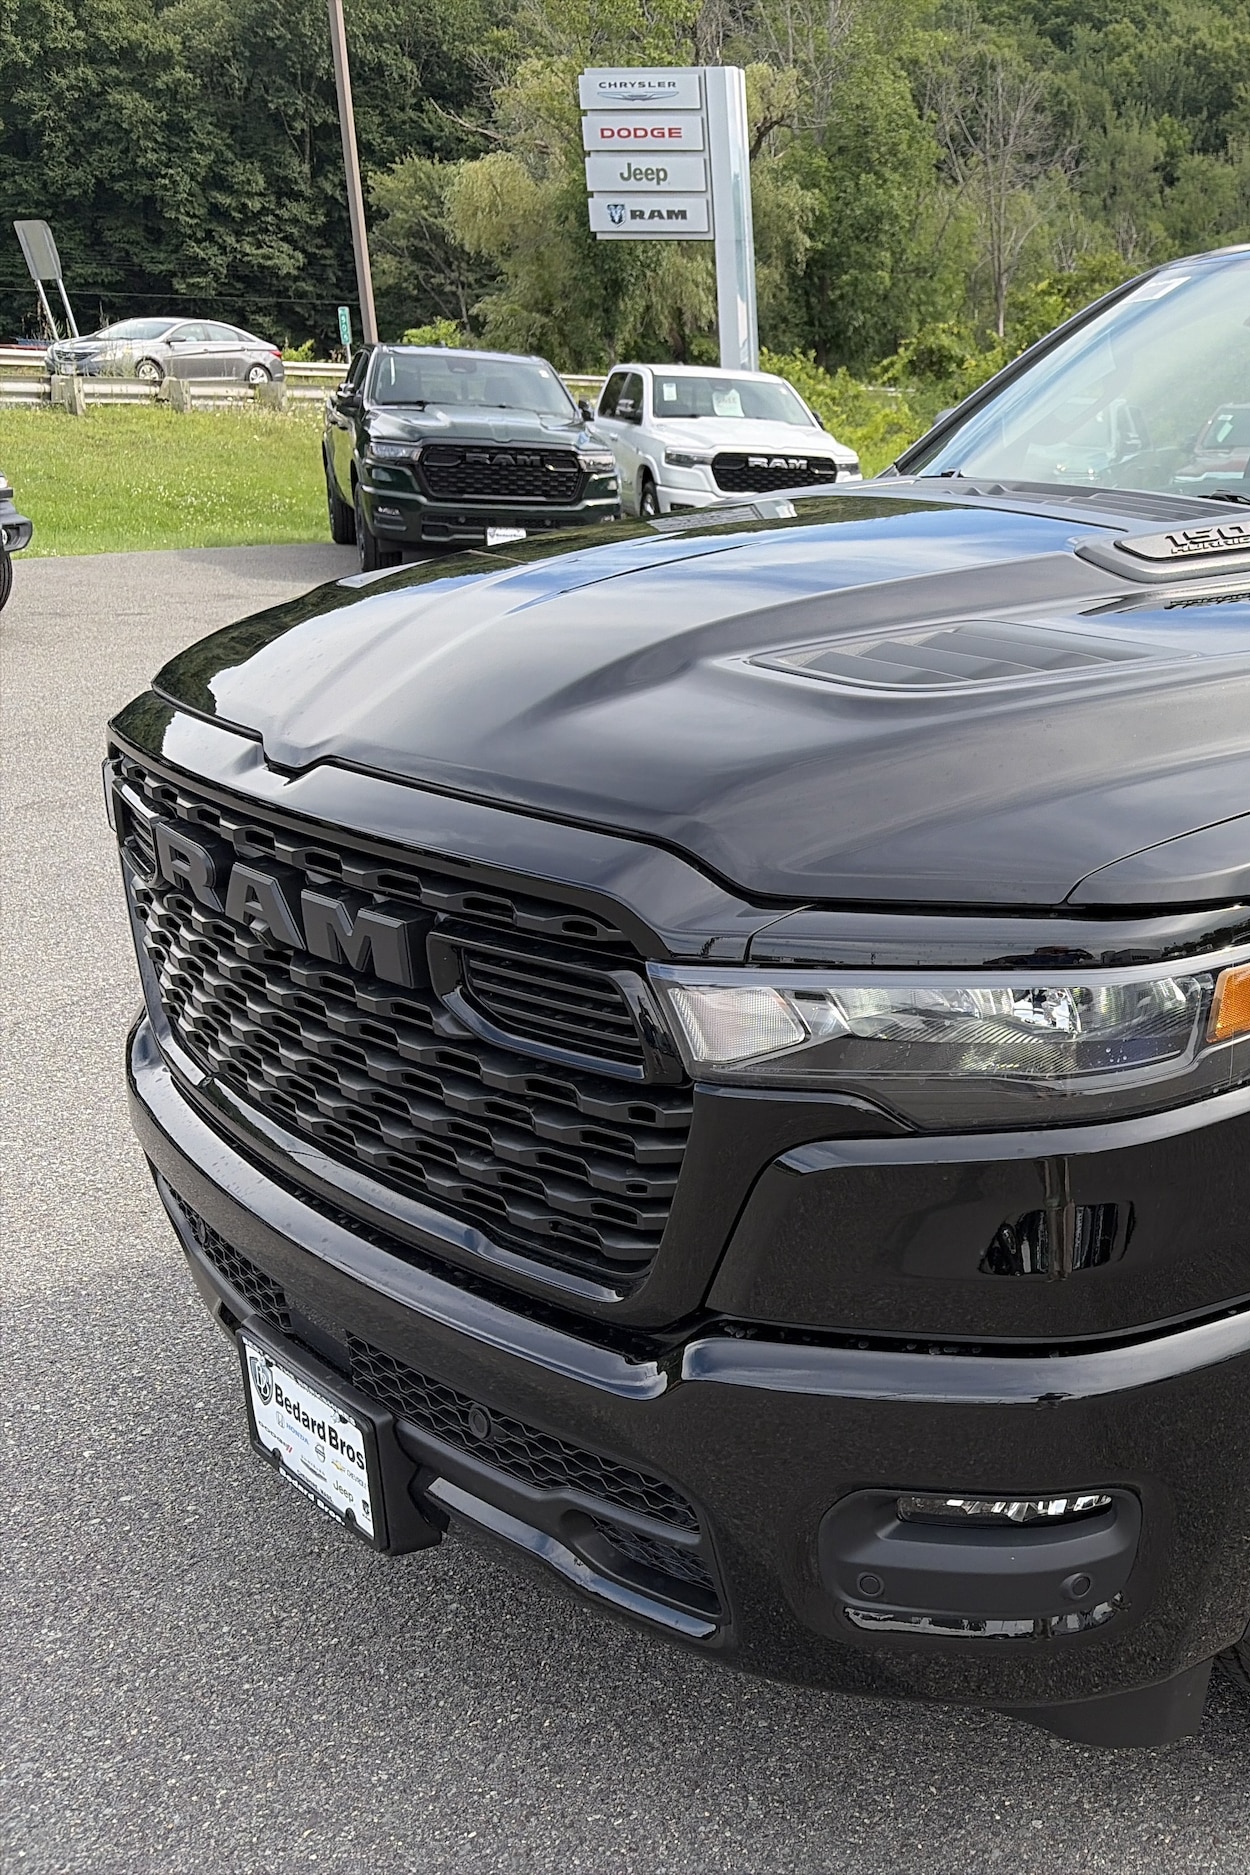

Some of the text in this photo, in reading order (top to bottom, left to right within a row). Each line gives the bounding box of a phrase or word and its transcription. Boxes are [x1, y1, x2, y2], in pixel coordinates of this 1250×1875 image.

[598, 81, 677, 89] CHRYSLER
[600, 127, 683, 139] DODGE
[619, 162, 669, 186] Jeep
[630, 209, 688, 221] RAM
[465, 453, 541, 466] RAM
[748, 456, 808, 470] RAM
[155, 819, 422, 989] RAM
[274, 1383, 327, 1442] Bedard
[328, 1425, 366, 1471] Bros
[333, 1480, 354, 1503] Jeep
